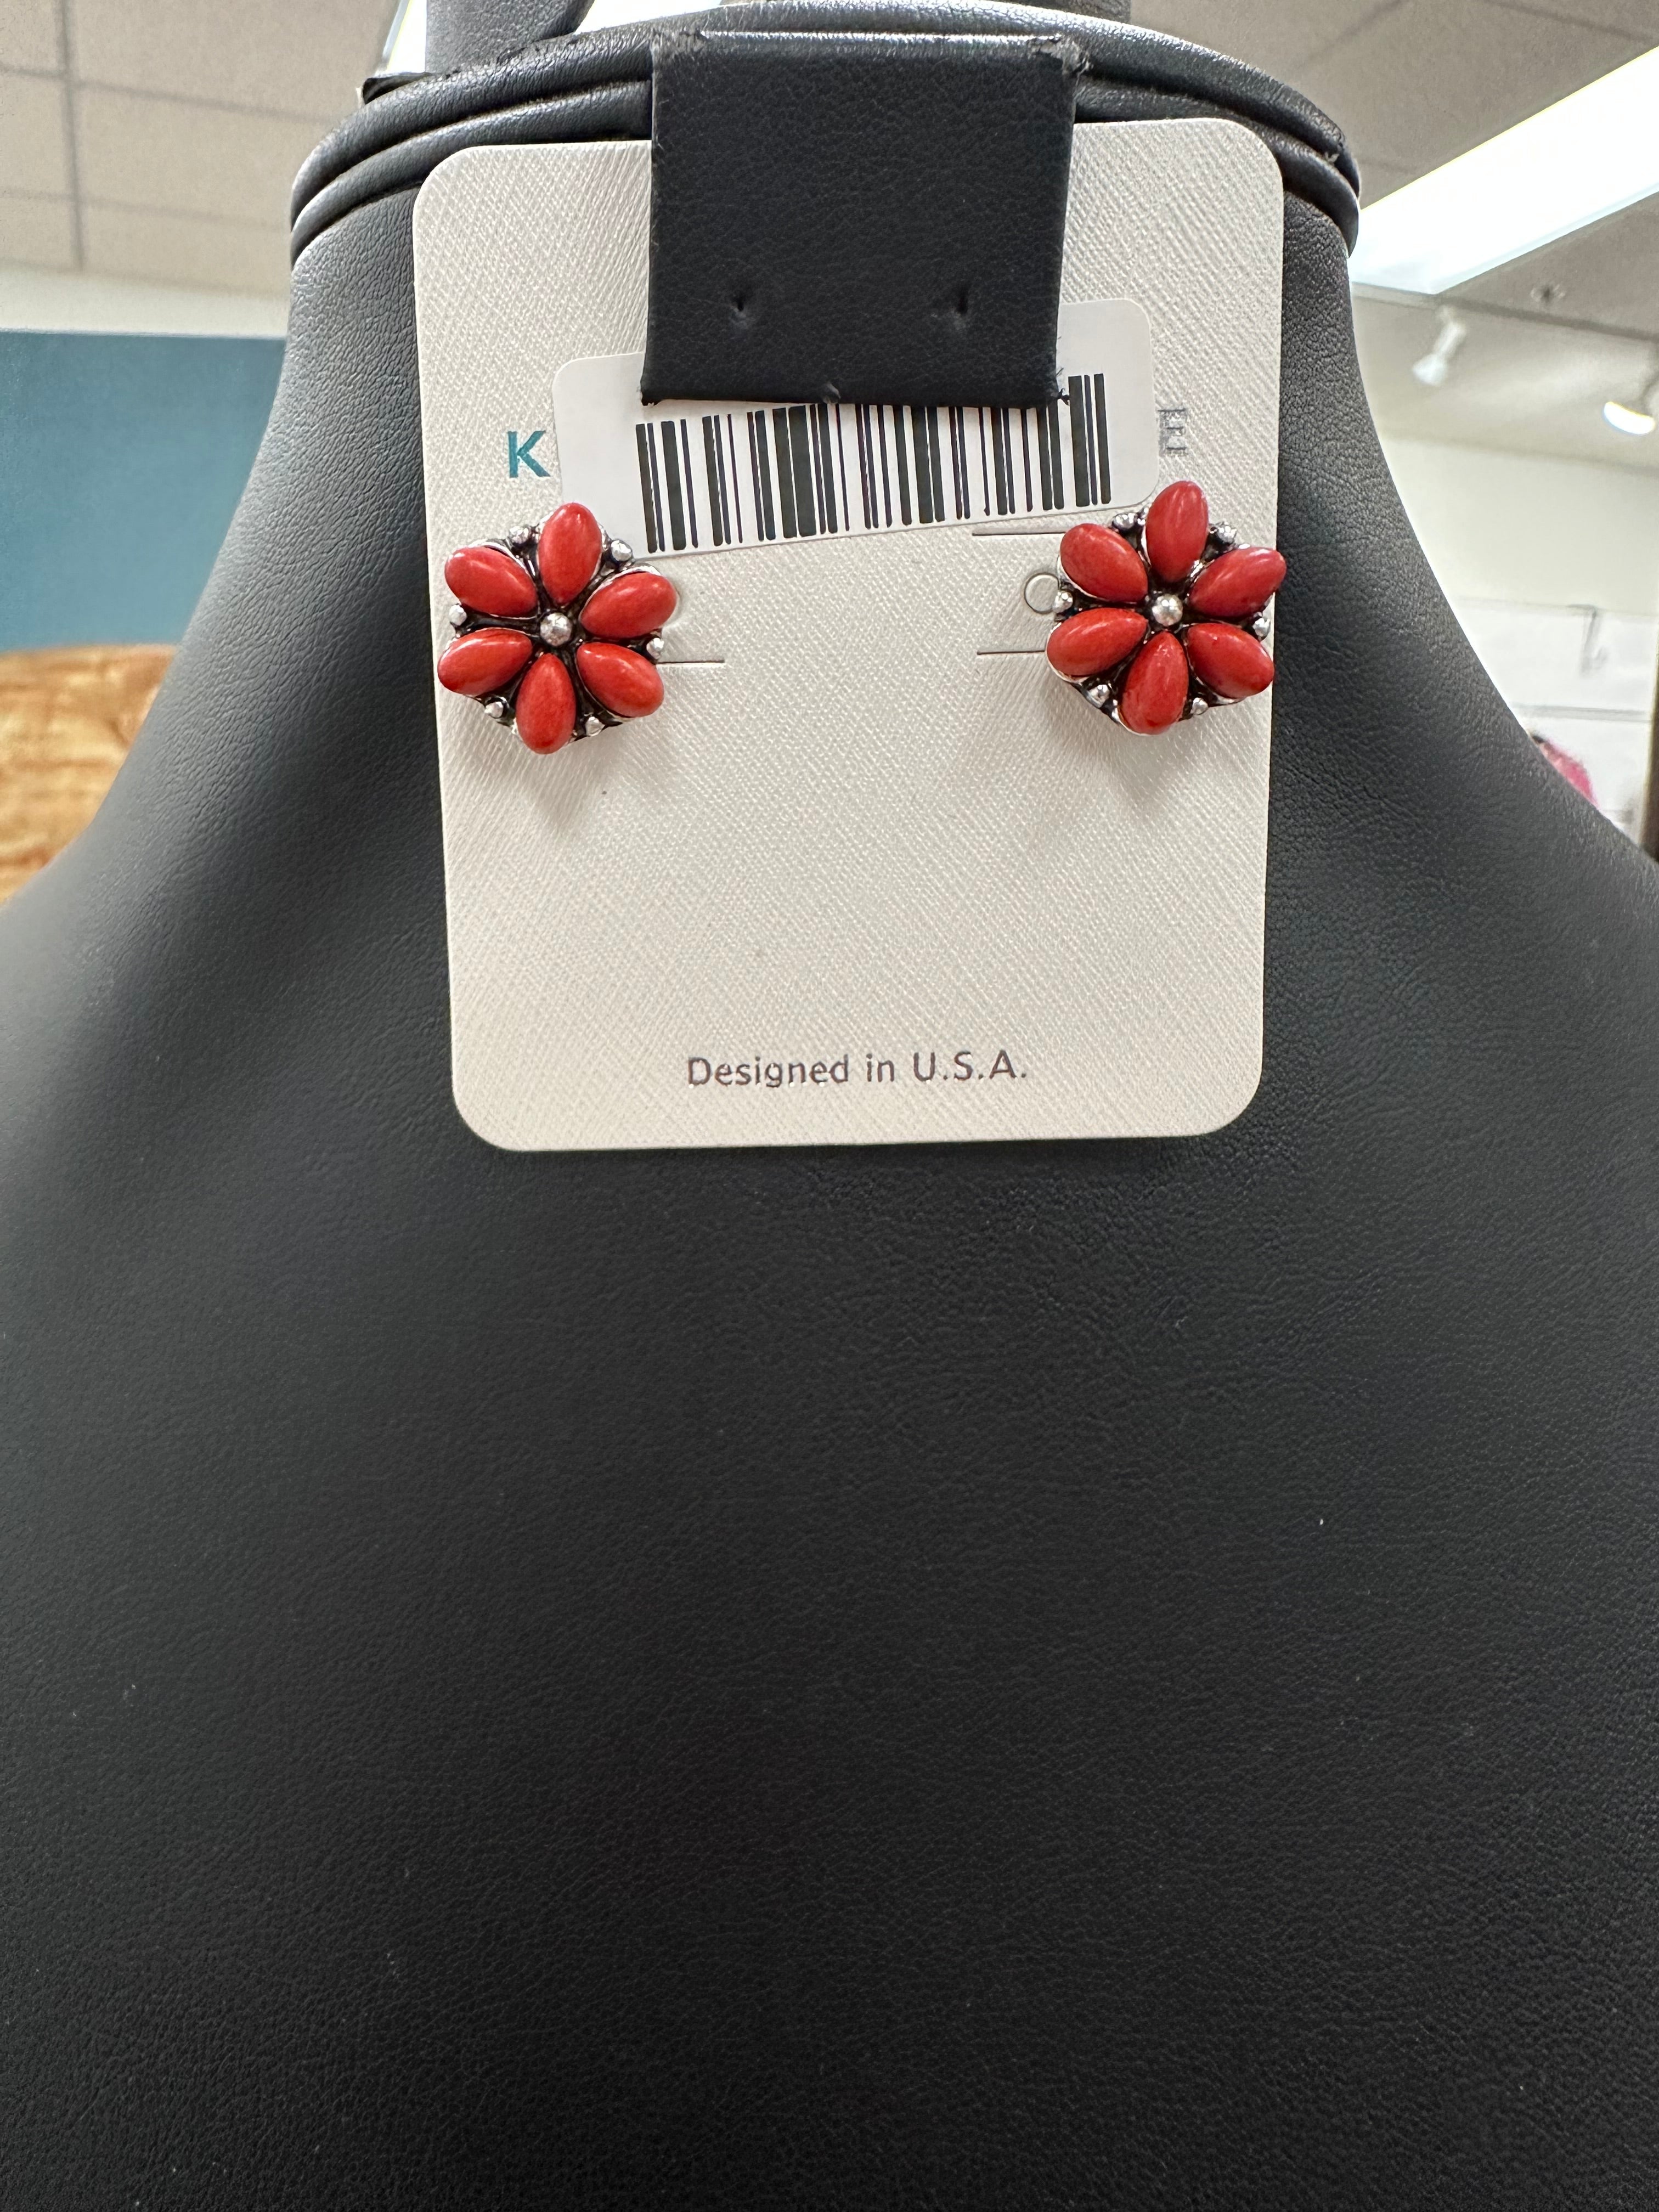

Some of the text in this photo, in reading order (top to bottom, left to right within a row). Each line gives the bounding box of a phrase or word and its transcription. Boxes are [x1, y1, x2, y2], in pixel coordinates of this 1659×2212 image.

[687, 1049, 1027, 1088] Designed in U.S.A.
